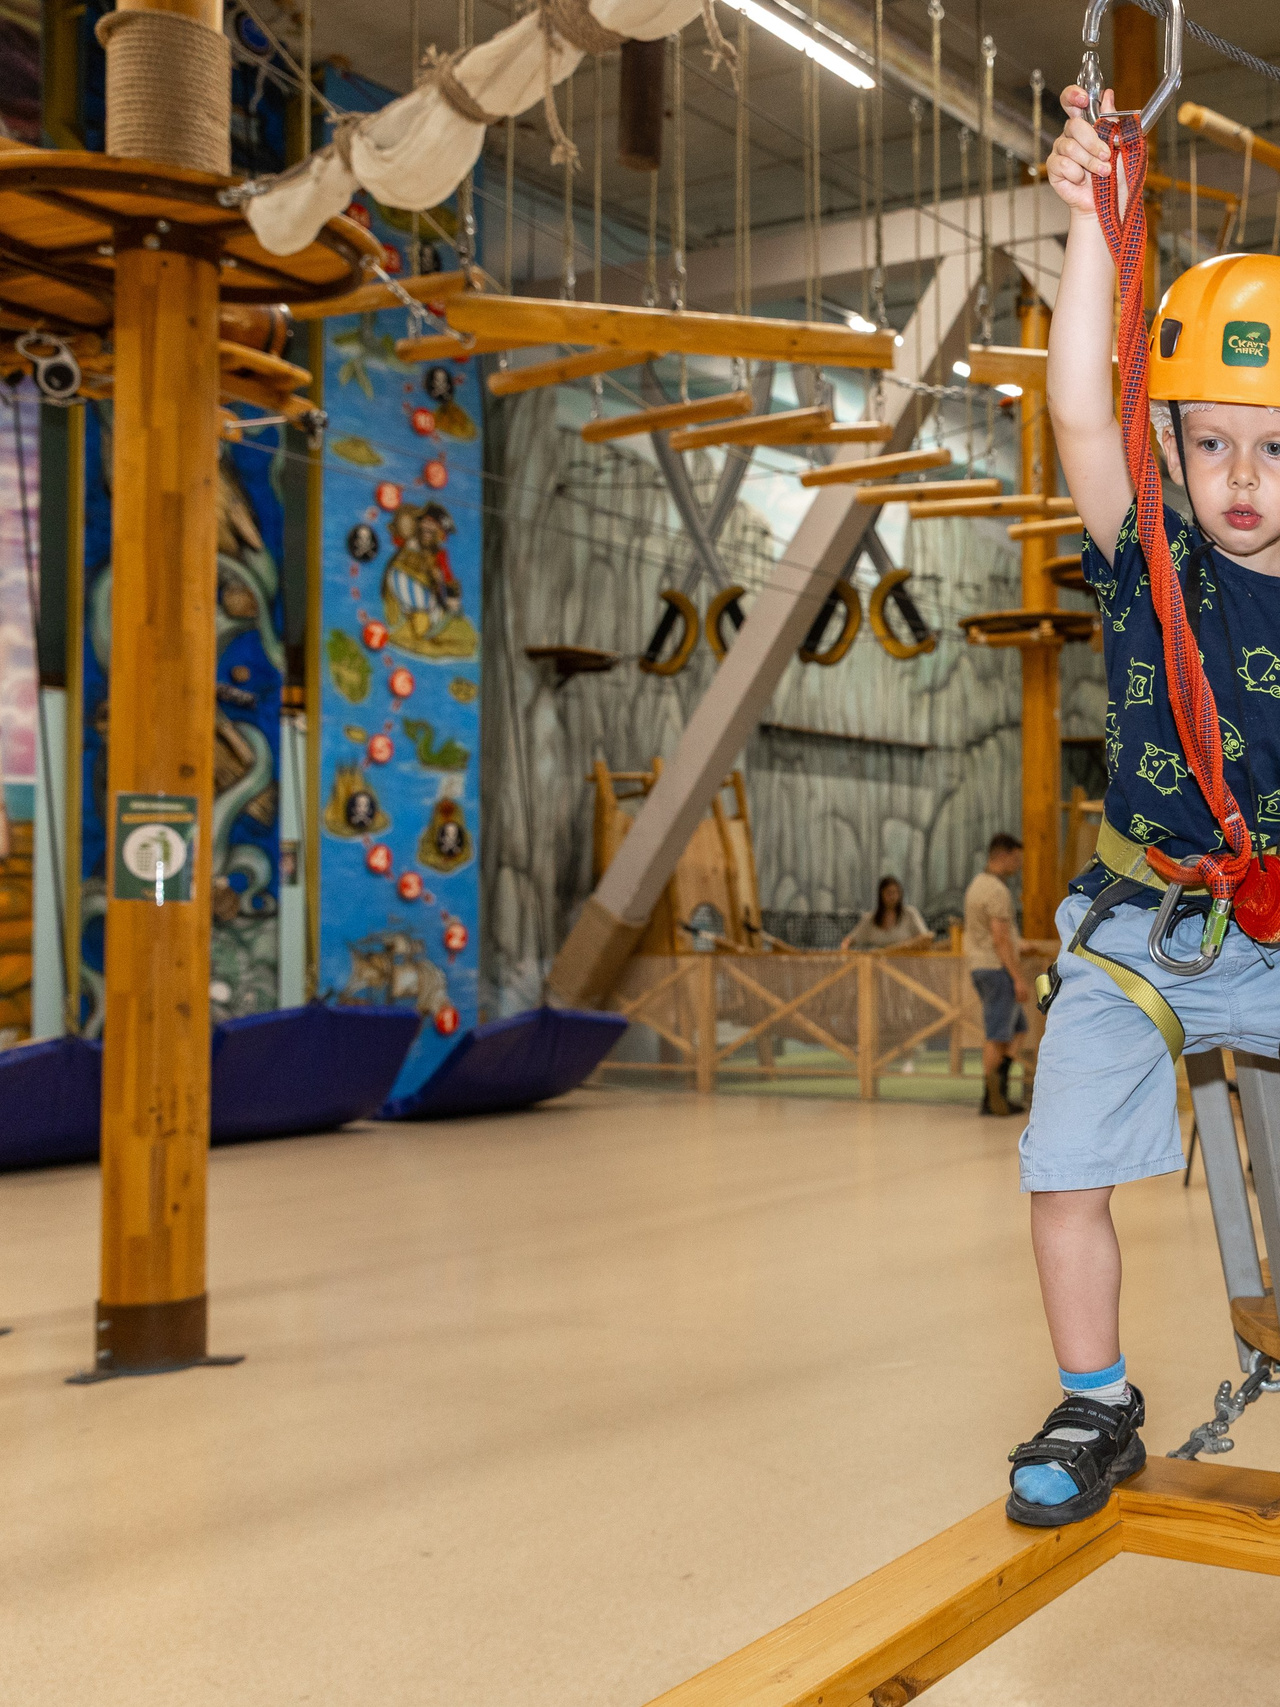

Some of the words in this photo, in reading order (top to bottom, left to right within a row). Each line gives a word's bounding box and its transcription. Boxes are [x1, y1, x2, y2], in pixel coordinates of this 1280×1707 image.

[367, 625, 384, 648] 7
[373, 737, 390, 761] 5
[370, 847, 386, 870] 4
[403, 874, 419, 897] 3
[448, 925, 463, 948] 2
[1087, 1409, 1098, 1417] FOR
